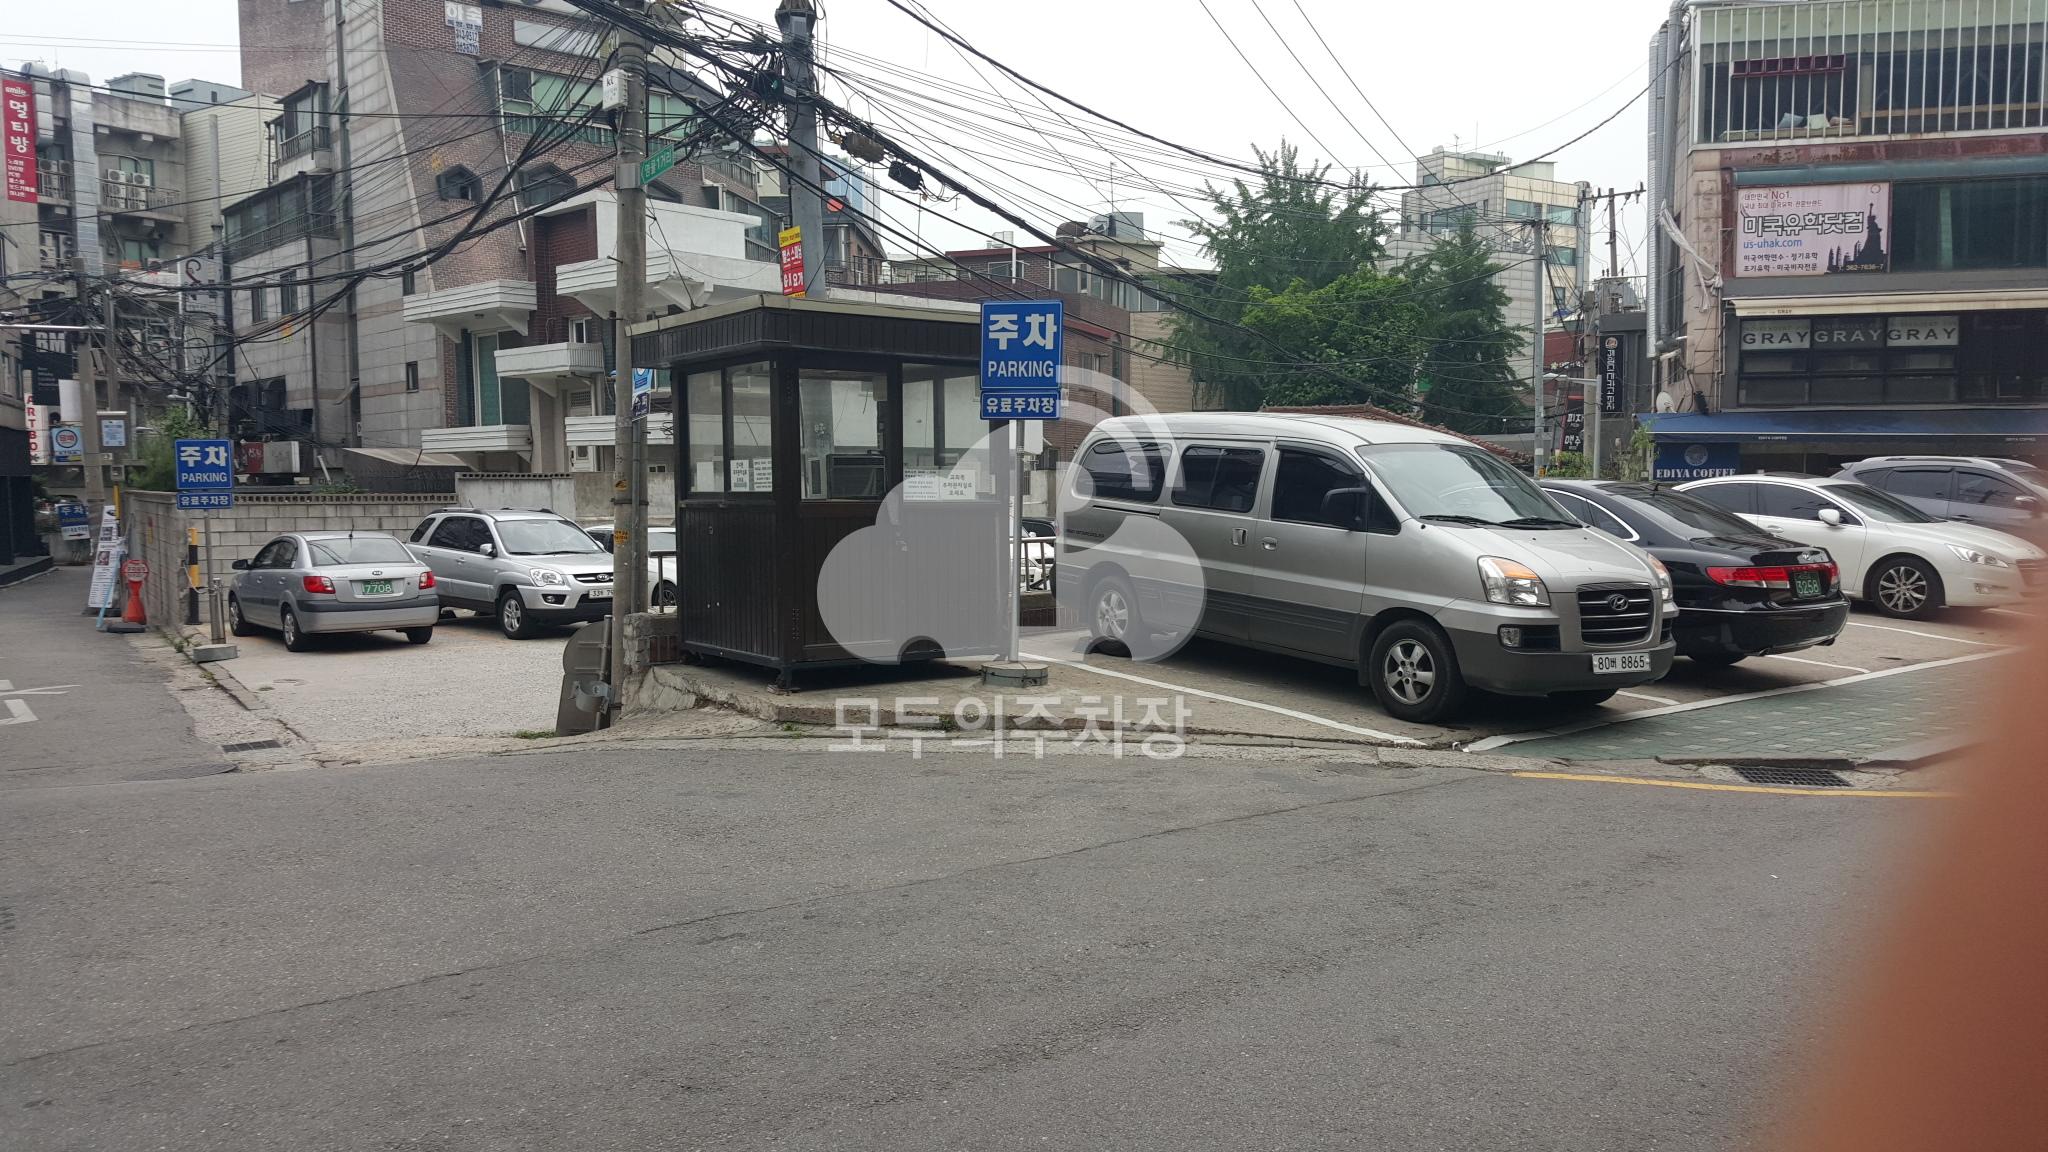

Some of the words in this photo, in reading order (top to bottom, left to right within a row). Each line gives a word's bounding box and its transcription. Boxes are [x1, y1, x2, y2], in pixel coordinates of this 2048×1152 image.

[9, 99, 30, 153] 멀티방
[1743, 212, 1864, 237] 미국유학닷컴
[1743, 239, 1802, 249] us-uhak.com
[1743, 253, 1785, 262] 미국어학연수
[1743, 264, 1770, 272] 조기유학
[1776, 263, 1817, 272] 미국비자전문
[989, 313, 1057, 350] 주차
[1743, 331, 1808, 344] GRAY
[1814, 329, 1882, 342] GRAY
[1887, 328, 1956, 340] GRAY
[988, 361, 1054, 377] PARKING
[987, 398, 1054, 413] 유료주차장
[180, 446, 227, 467] 주차
[181, 472, 228, 482] PARKING
[1656, 469, 1689, 478] EDIYA
[181, 496, 229, 505] 유료주차장
[365, 584, 391, 593] 7708
[1796, 580, 1819, 593] 3258
[1598, 657, 1616, 670] 80버
[1621, 655, 1645, 669] 8865
